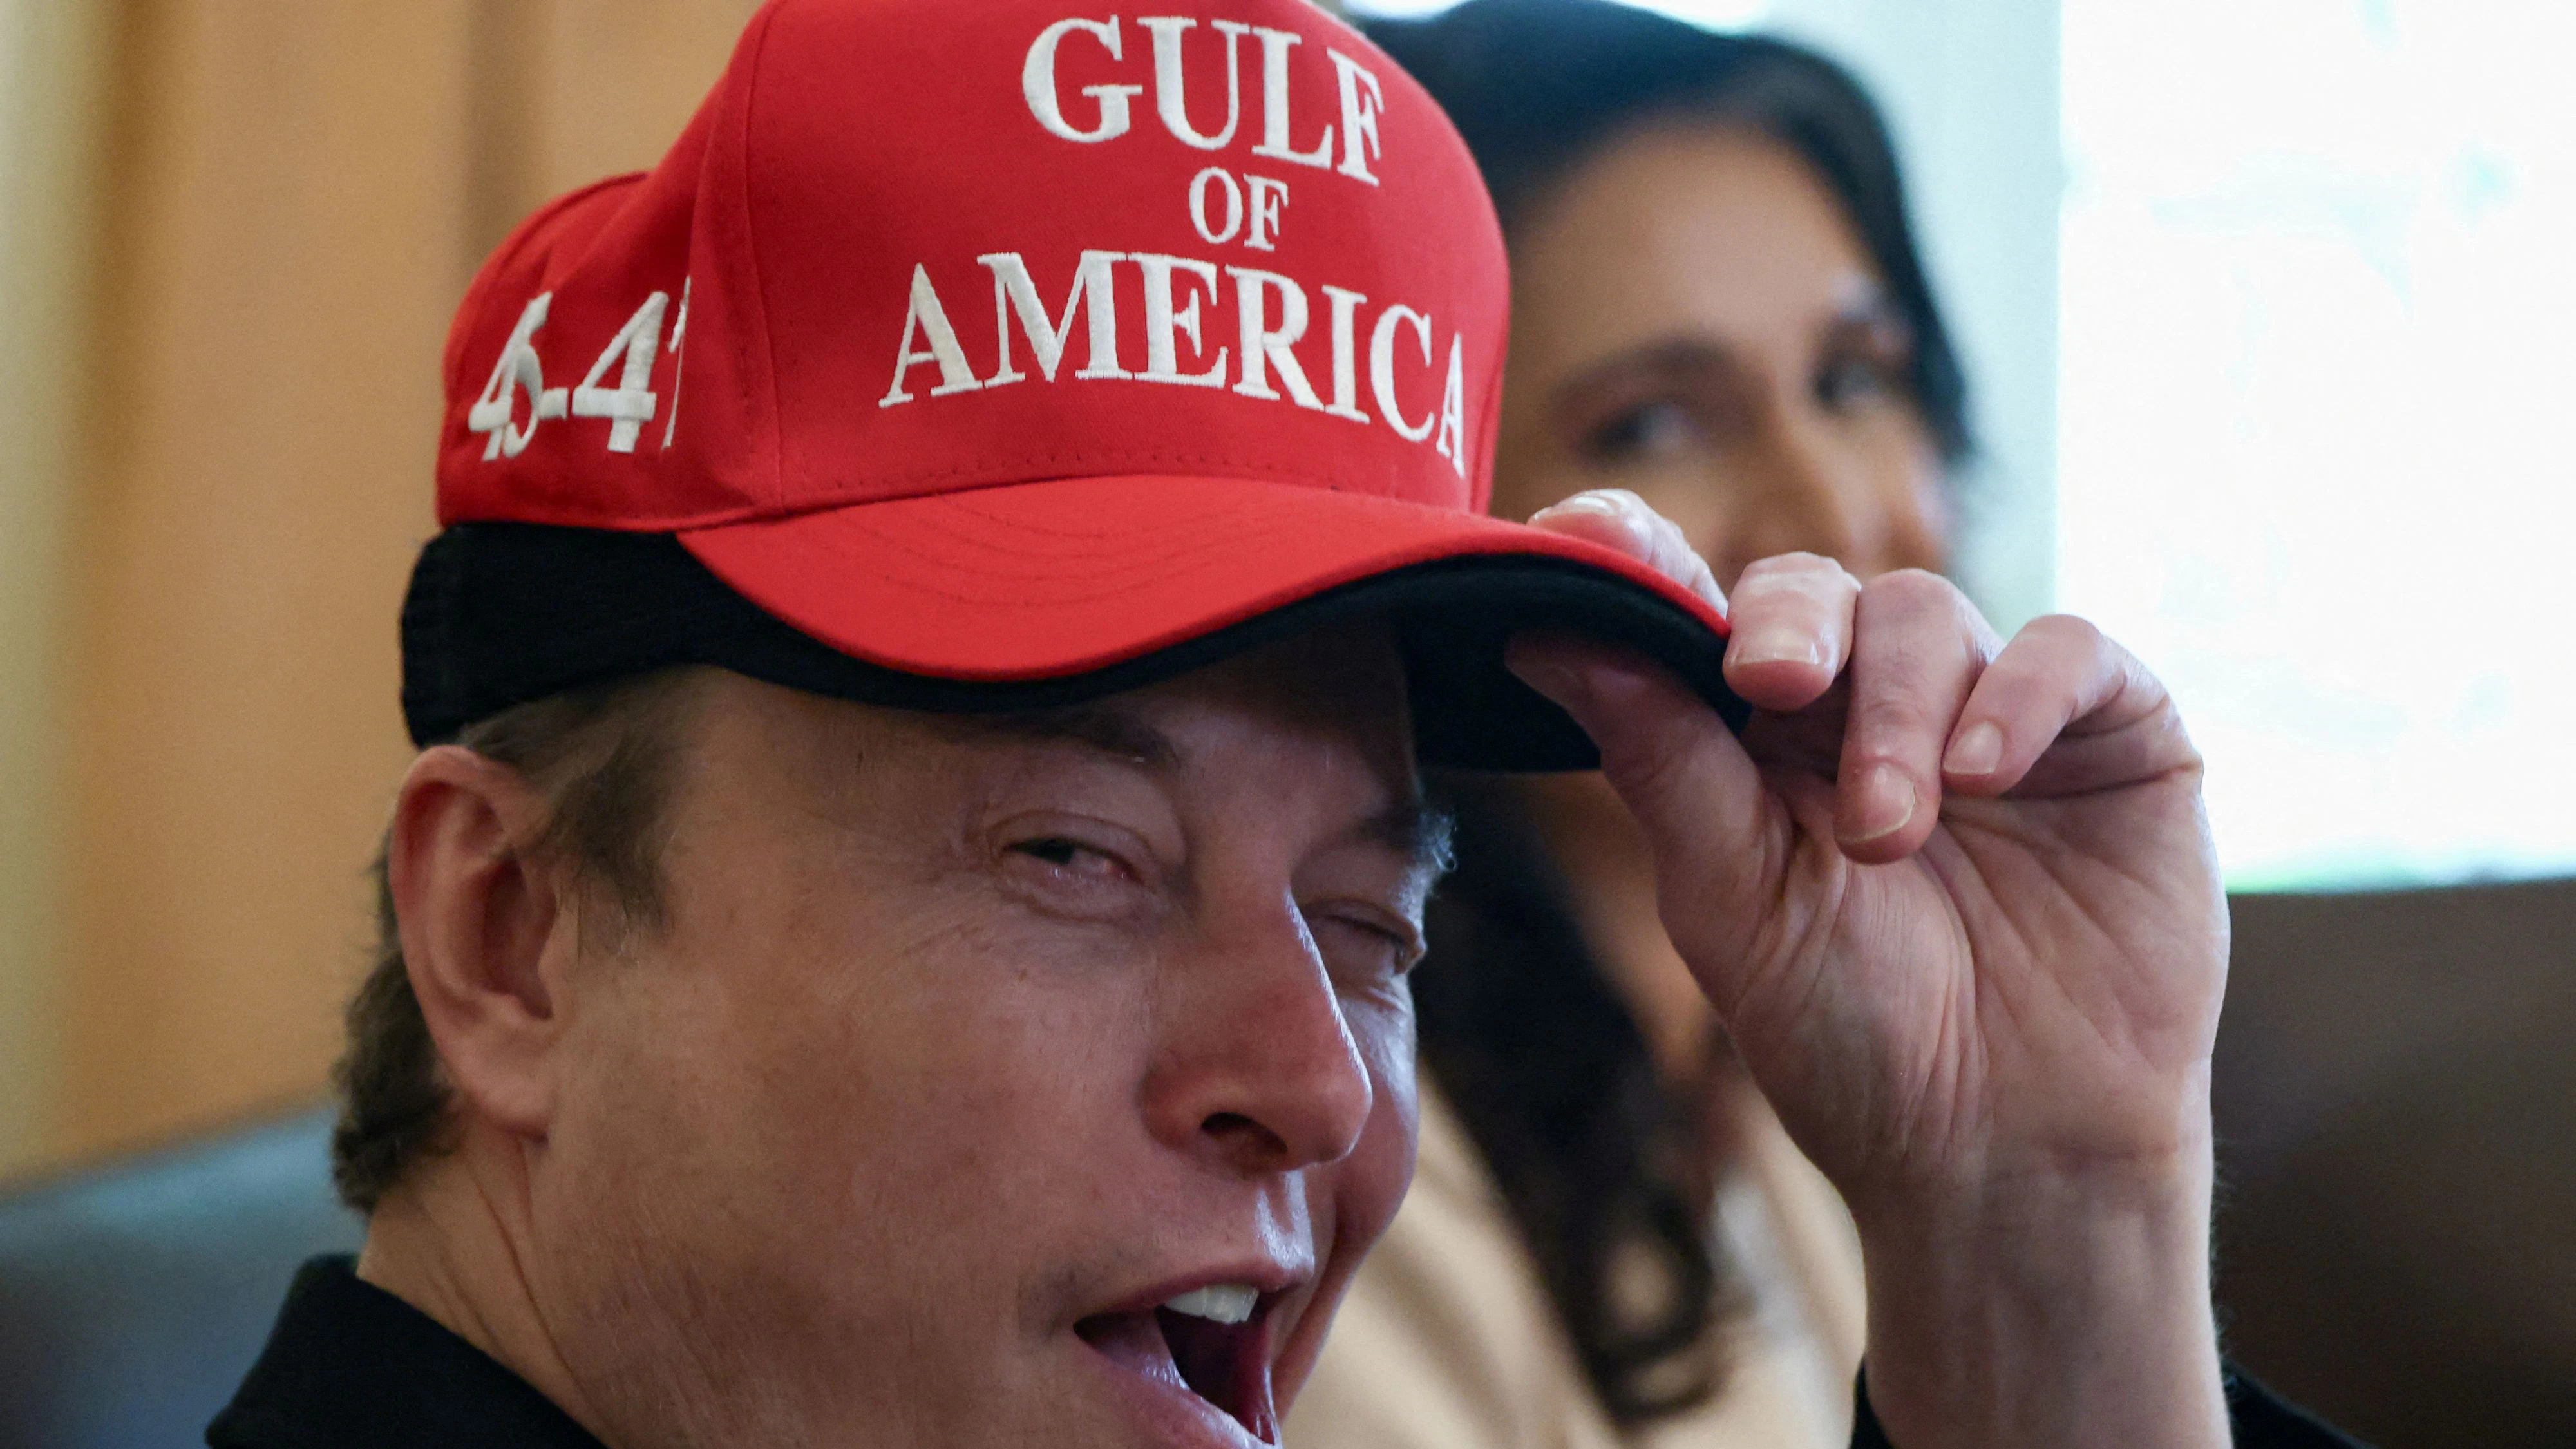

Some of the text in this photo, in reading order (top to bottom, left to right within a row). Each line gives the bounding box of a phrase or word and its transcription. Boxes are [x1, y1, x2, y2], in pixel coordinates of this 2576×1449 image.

[1021, 14, 1386, 187] GULF
[1188, 166, 1290, 252] OF
[878, 249, 1468, 484] AMERICA
